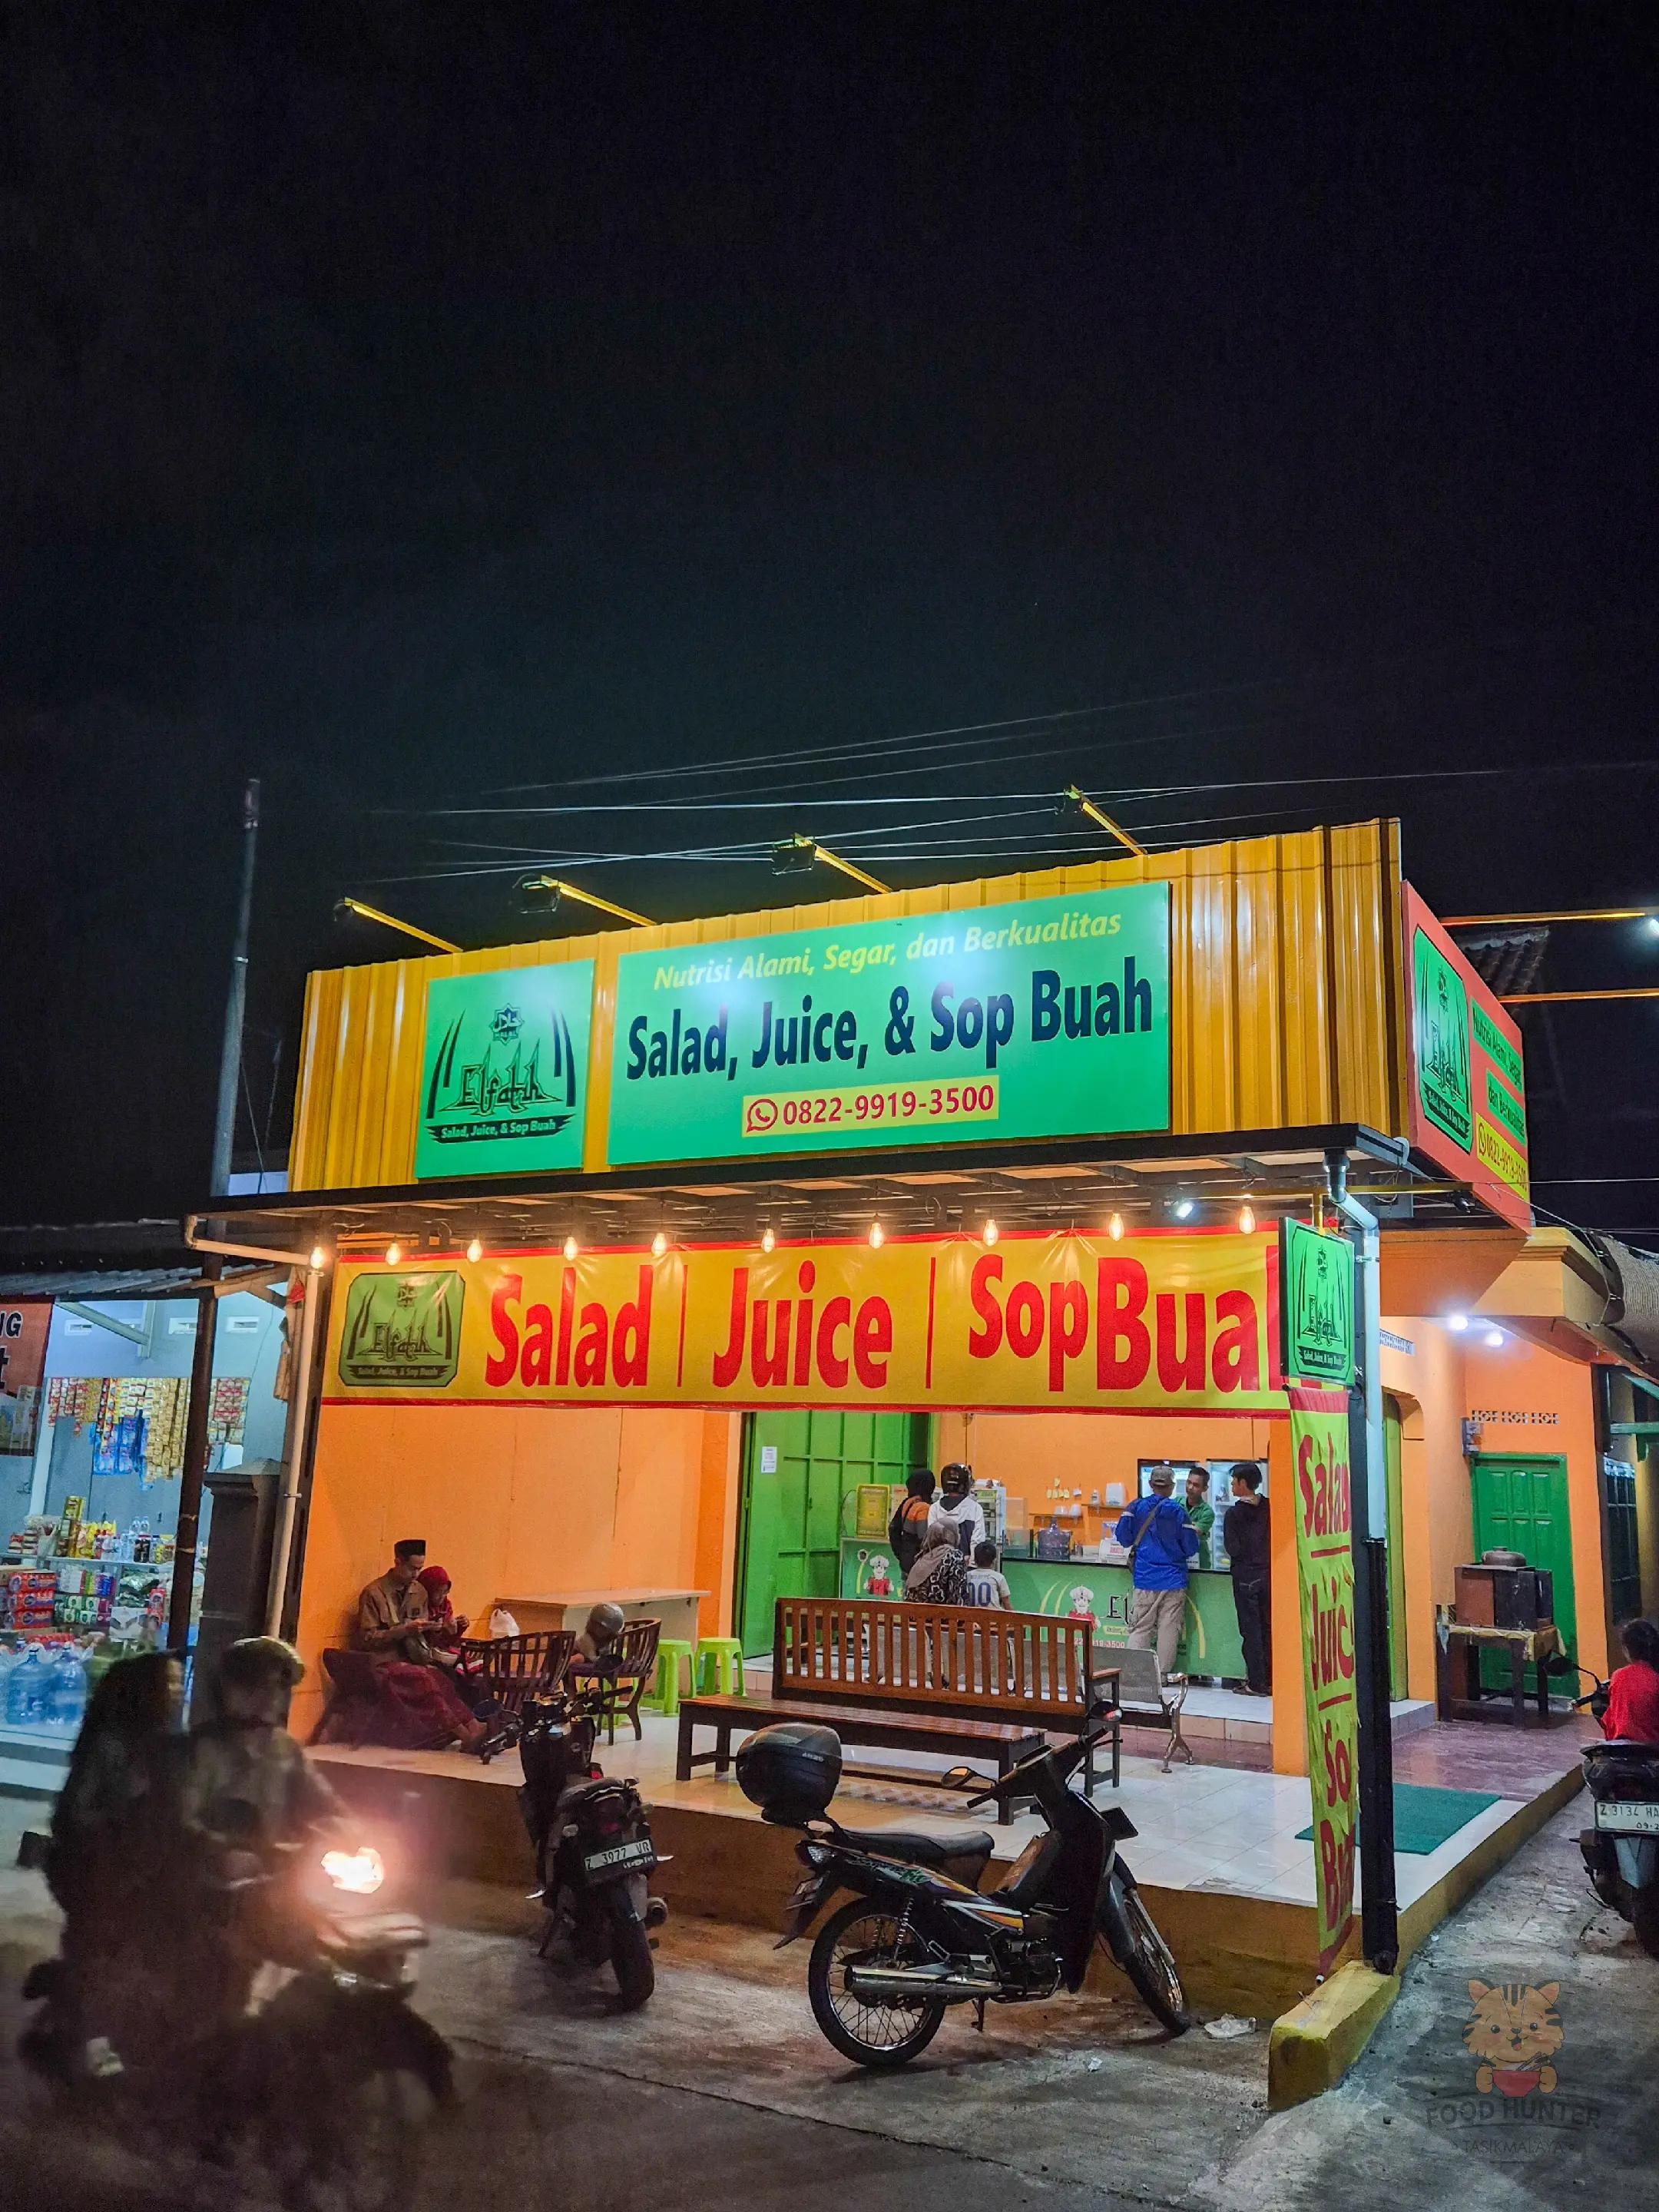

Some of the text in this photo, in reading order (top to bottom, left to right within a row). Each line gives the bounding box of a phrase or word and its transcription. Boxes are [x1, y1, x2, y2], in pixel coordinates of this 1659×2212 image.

[654, 912, 1121, 991] Nutrisi Alami, Segar, dan Berkualitas
[627, 955, 1152, 1081] Salad, Juice, & Sop Buah
[783, 1084, 995, 1125] 0822-9919-3500
[485, 1265, 653, 1387] Salad
[713, 1260, 892, 1389] Juice
[601, 1847, 626, 1863] 3977
